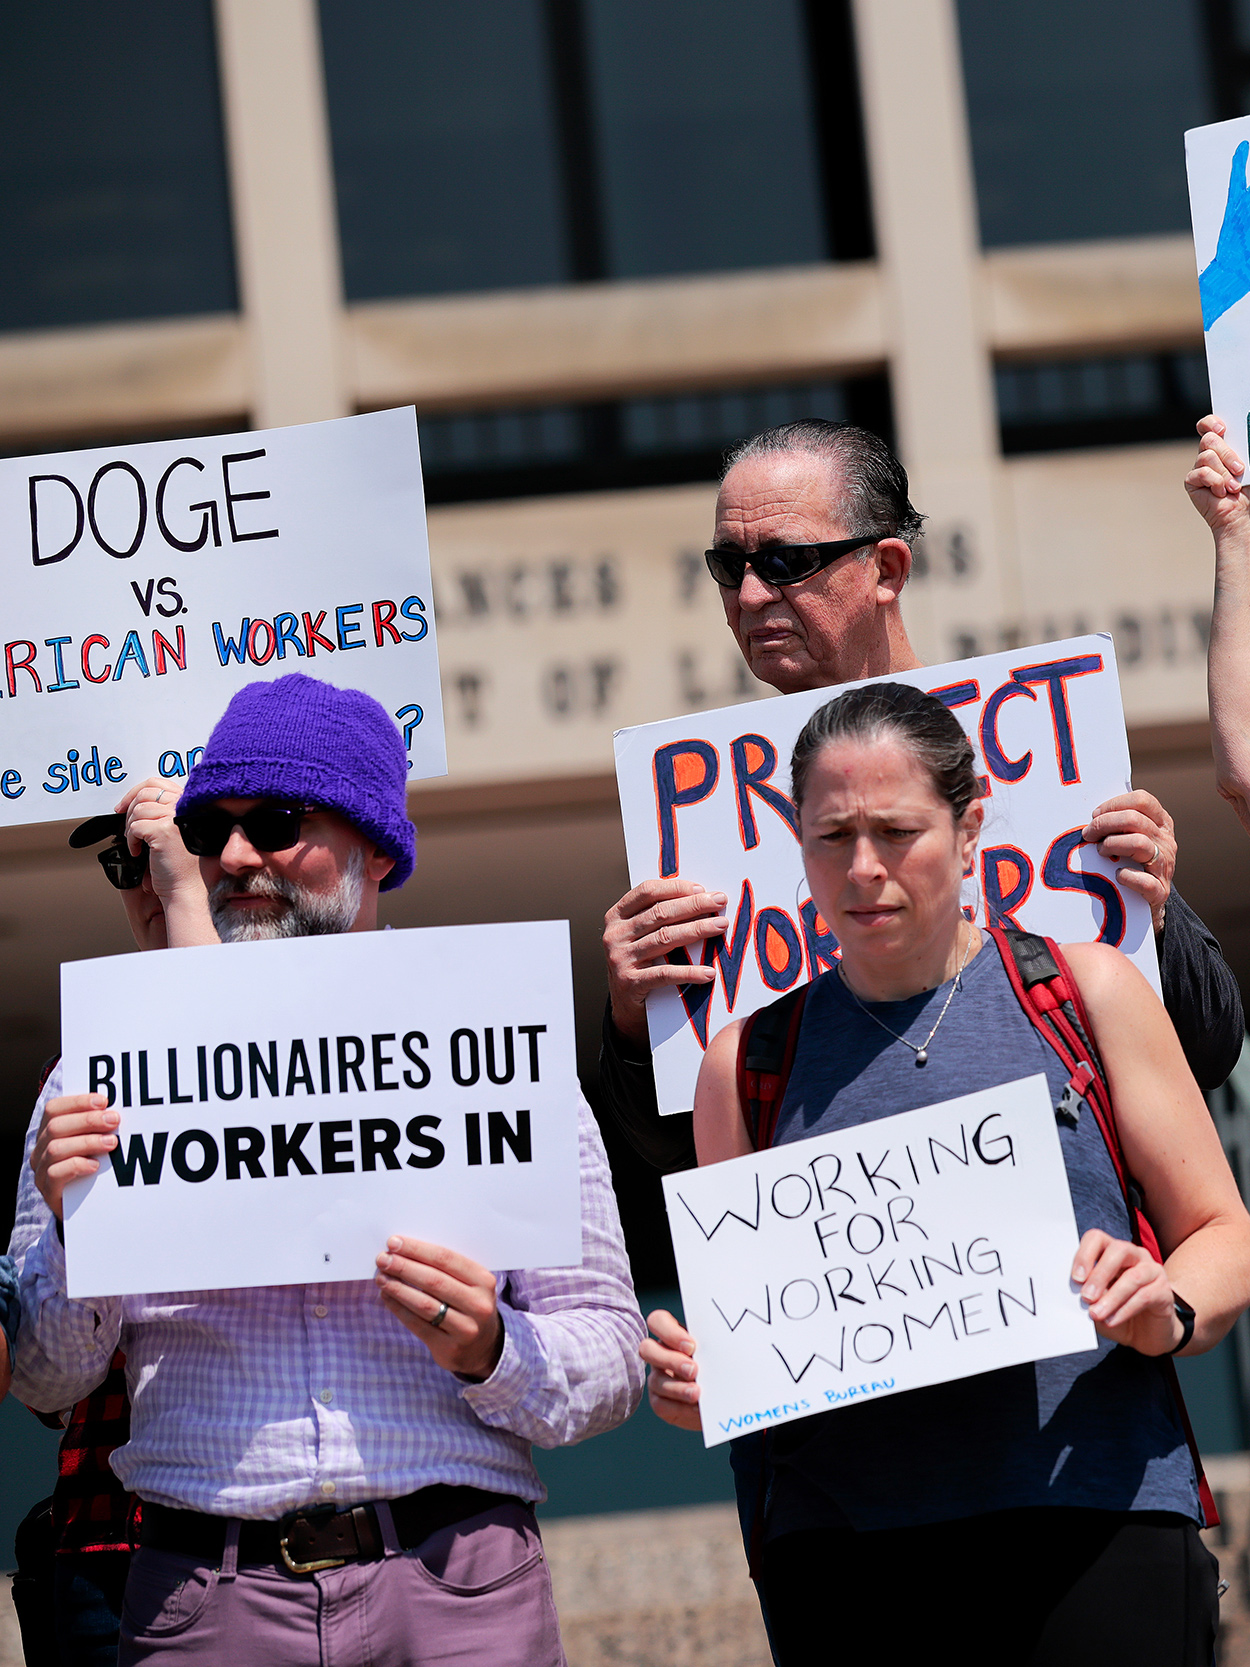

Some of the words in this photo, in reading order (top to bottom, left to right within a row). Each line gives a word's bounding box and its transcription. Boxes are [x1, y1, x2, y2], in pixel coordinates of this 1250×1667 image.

[28, 448, 280, 567] DOGE
[0, 625, 188, 699] RICAN
[212, 595, 429, 667] WORKERS
[42, 746, 128, 794] side
[652, 653, 1104, 879] PRCT
[663, 823, 1125, 1052] WORRS
[88, 1030, 432, 1108] BILLIONAIRES
[449, 1024, 548, 1087] OUT
[110, 1114, 446, 1188] WORKERS
[464, 1109, 533, 1166] IN
[677, 1113, 1016, 1241] WORKING
[813, 1195, 929, 1259] FOR
[711, 1237, 1004, 1332] WORKING
[771, 1276, 1037, 1384] WOMEN
[718, 1398, 811, 1433] WOMENS
[823, 1378, 897, 1405] BUREAU
